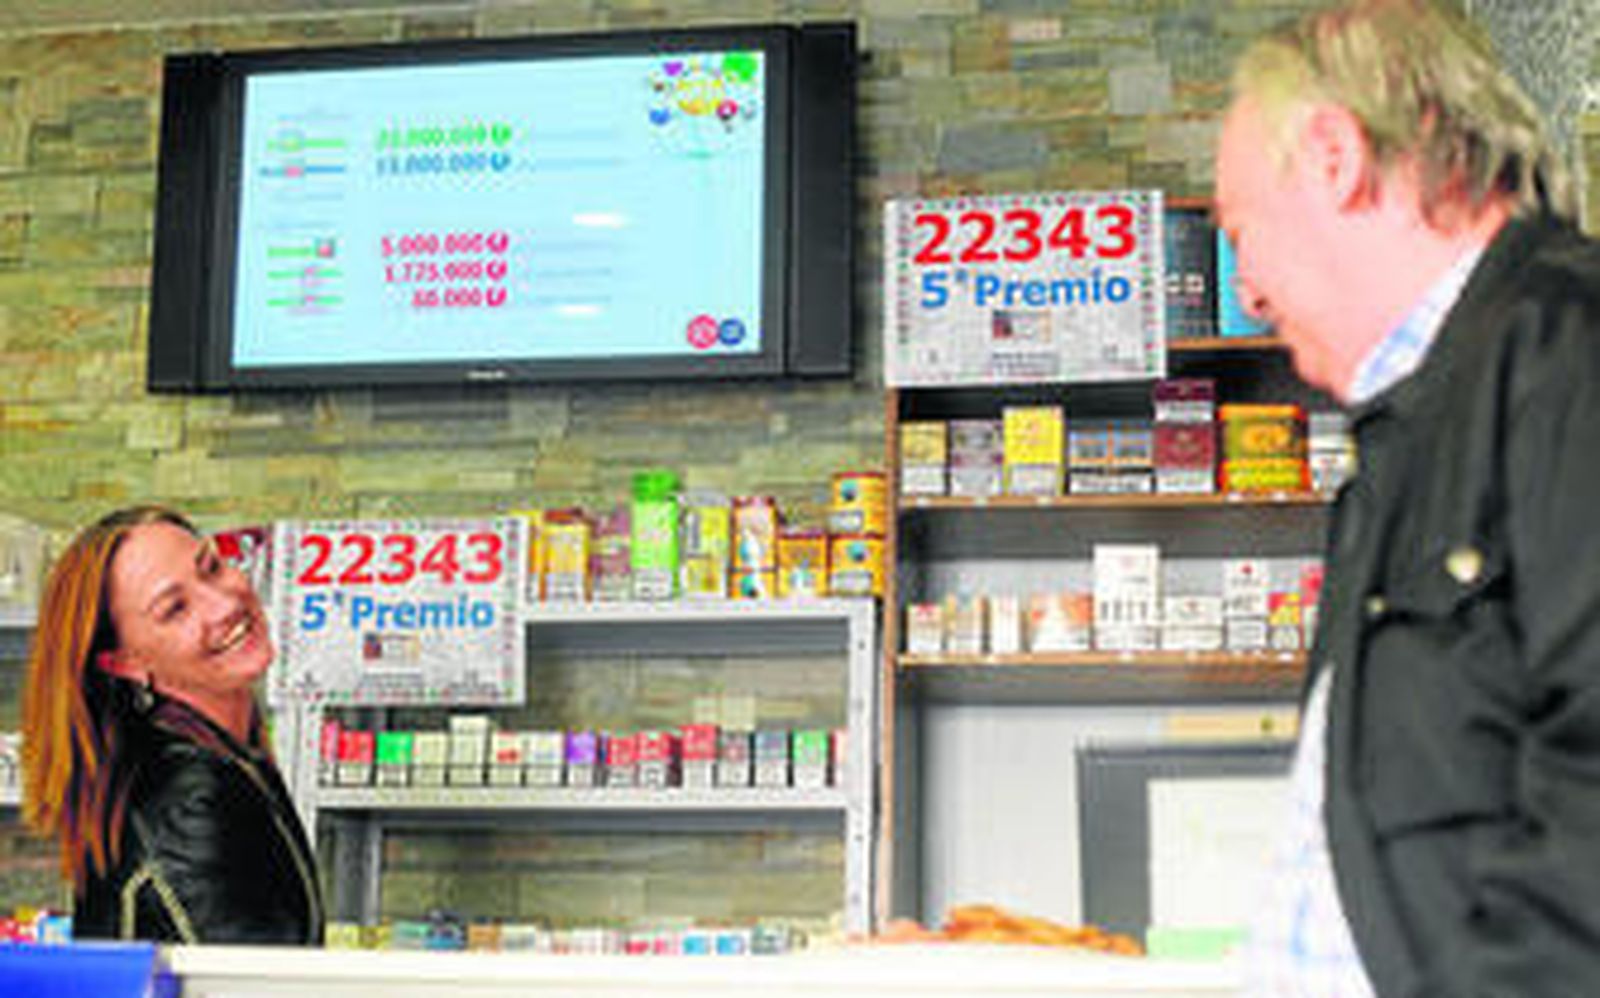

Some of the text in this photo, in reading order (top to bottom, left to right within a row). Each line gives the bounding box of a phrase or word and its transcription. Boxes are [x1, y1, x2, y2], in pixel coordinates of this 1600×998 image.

[913, 205, 1136, 264] 22343
[974, 268, 1131, 307] Premio
[297, 533, 503, 585] 22343
[351, 592, 495, 629] Premio
